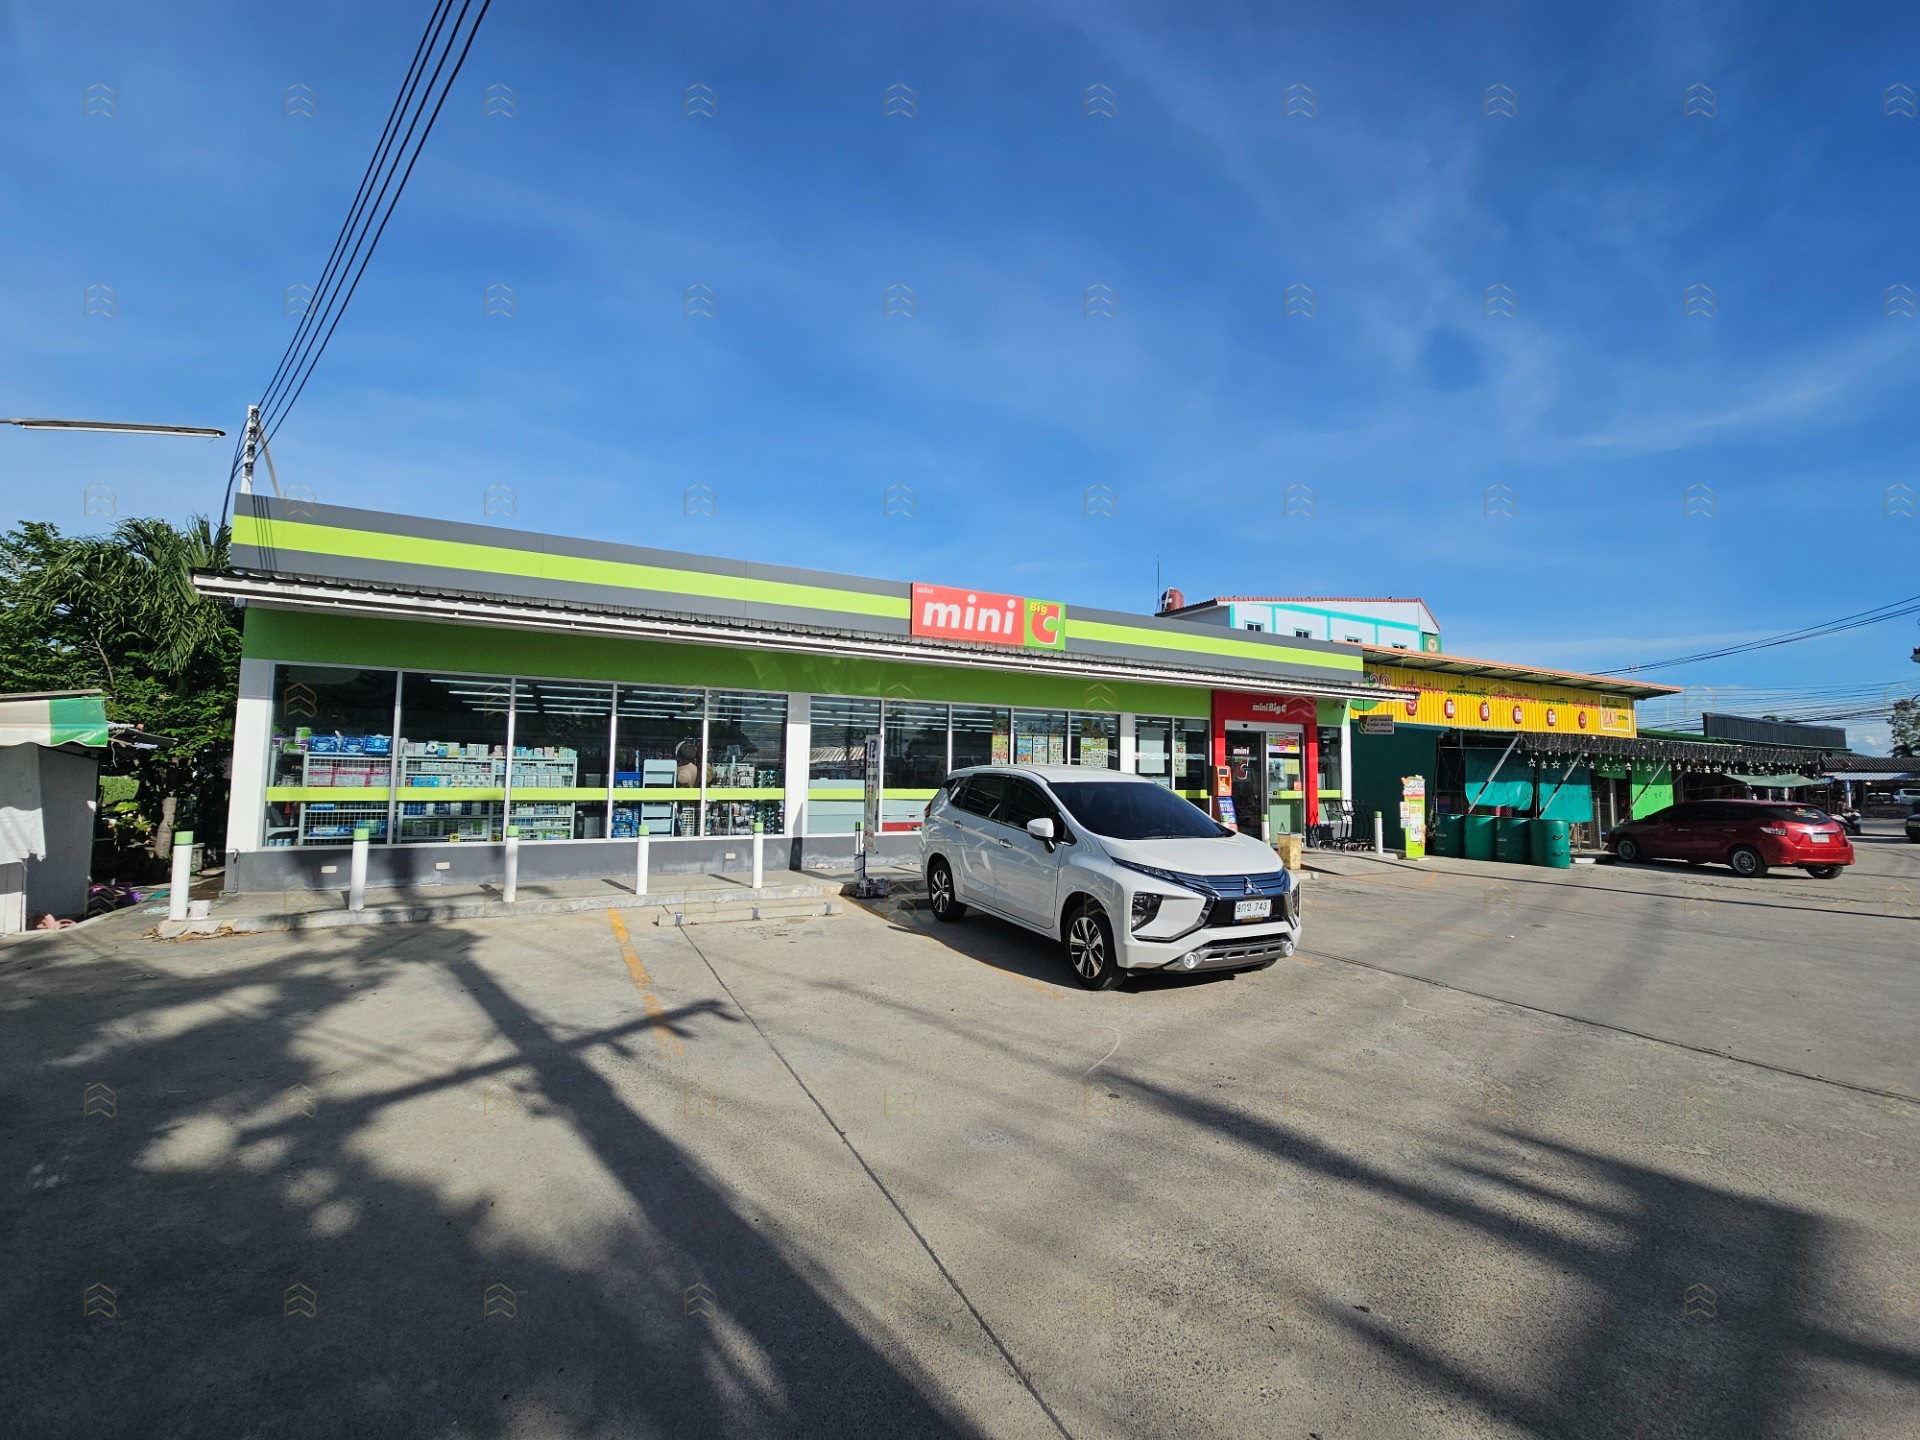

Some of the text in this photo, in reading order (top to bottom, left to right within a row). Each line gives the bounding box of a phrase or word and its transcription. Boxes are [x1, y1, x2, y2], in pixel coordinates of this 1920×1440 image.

[922, 594, 1016, 635] mini
[1029, 602, 1048, 615] Big
[1031, 604, 1061, 645] C
[1252, 703, 1269, 712] mini
[1269, 703, 1281, 714] Big
[1233, 747, 1250, 755] mini
[1255, 901, 1267, 911] 743
